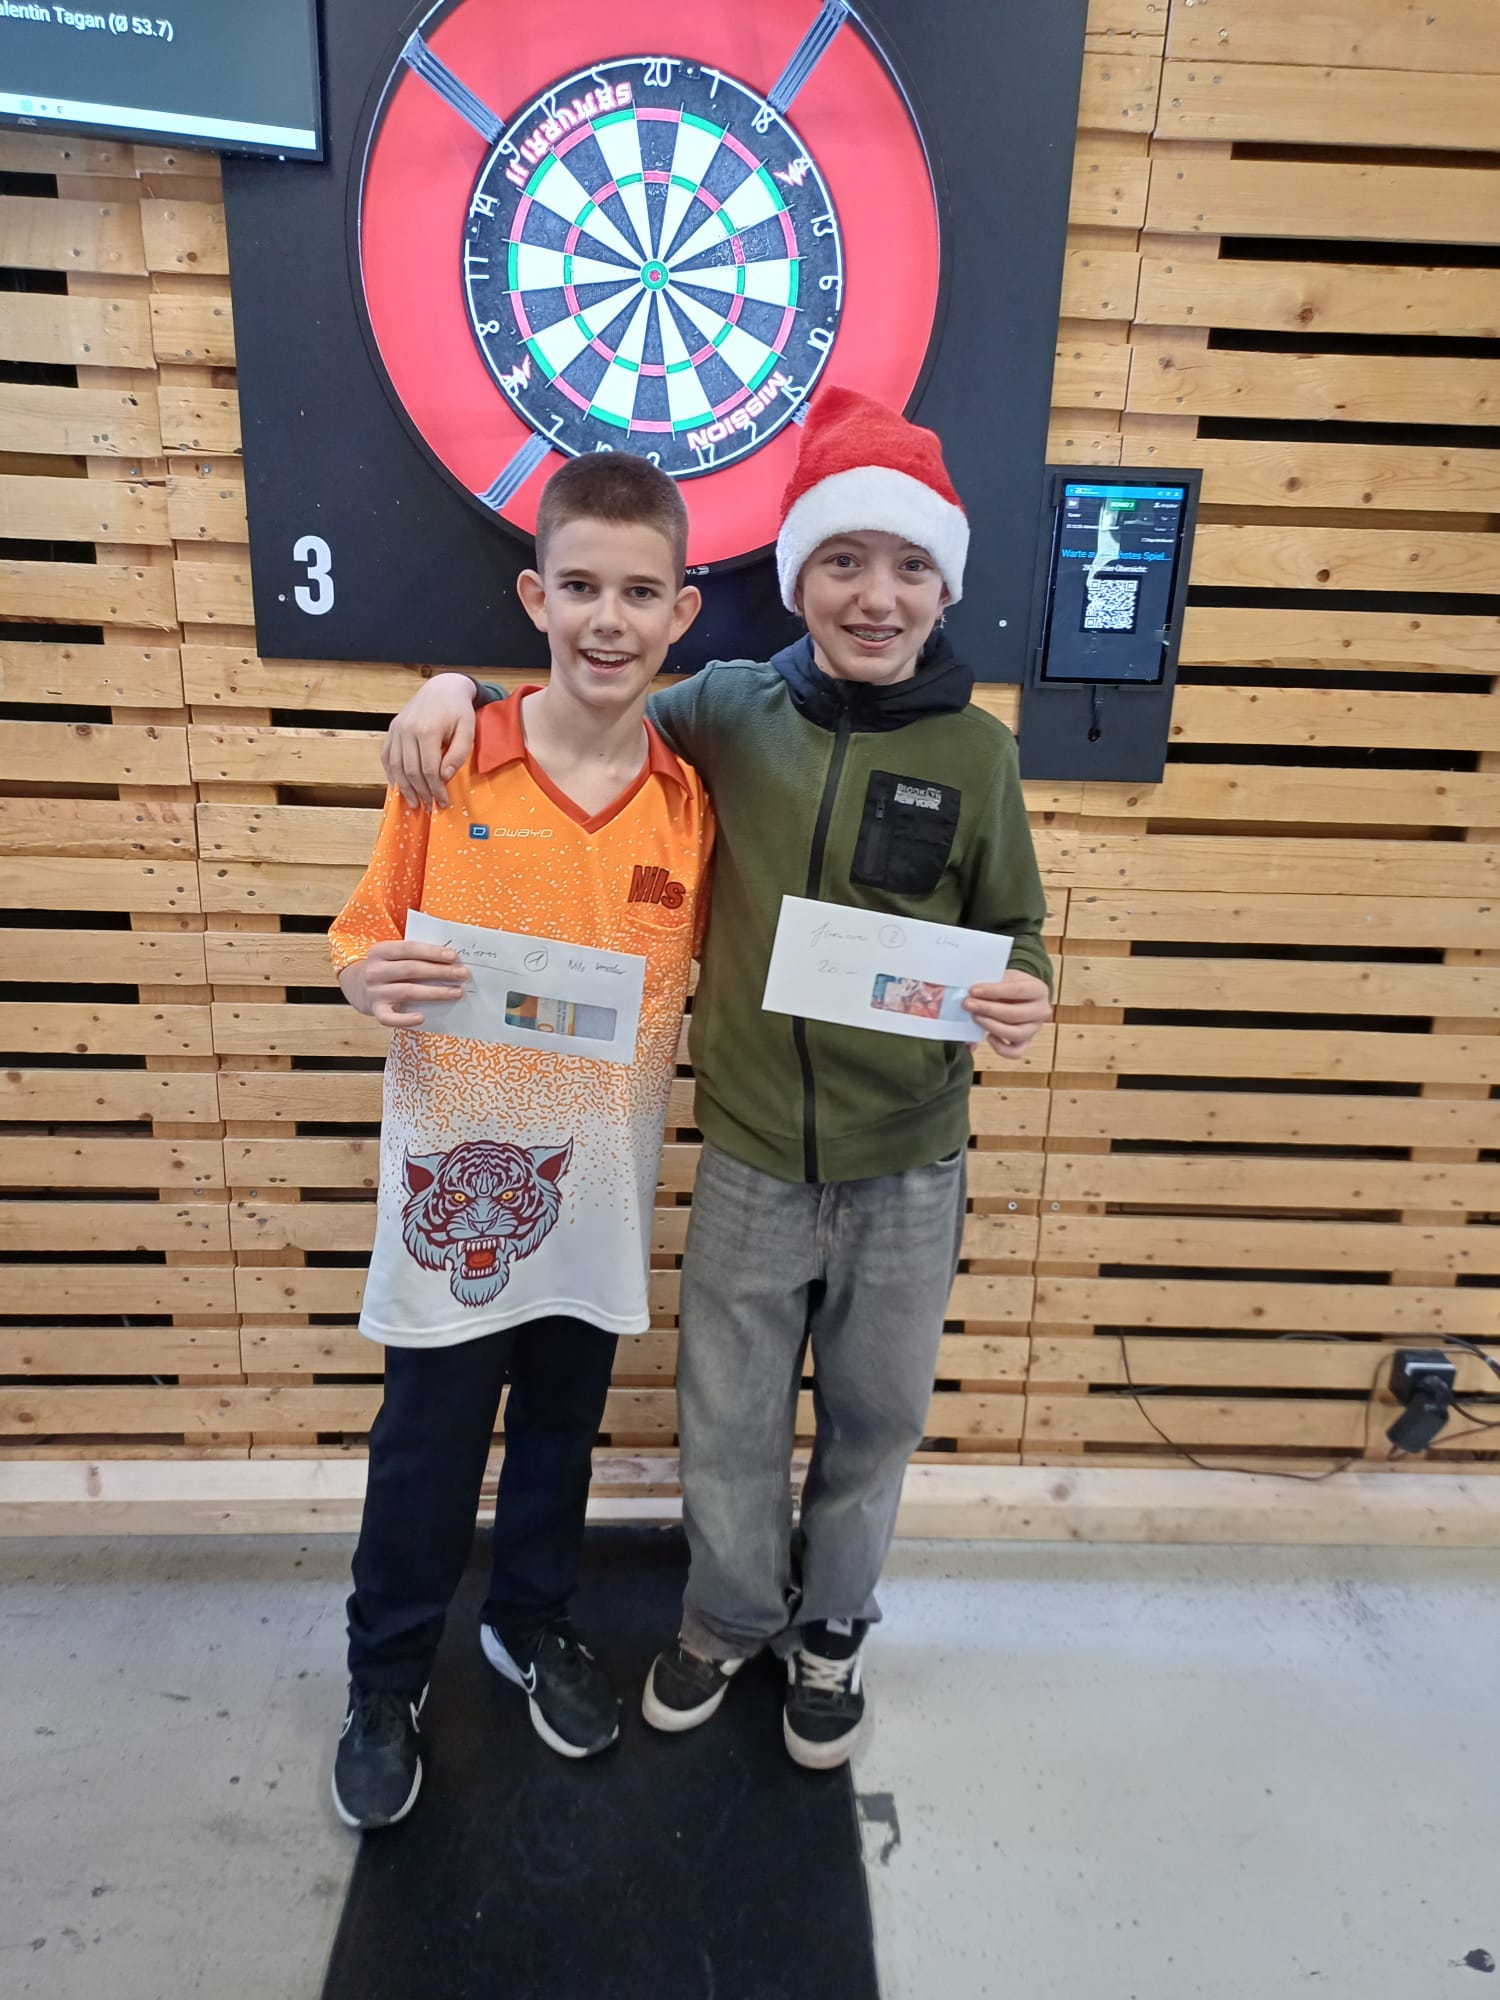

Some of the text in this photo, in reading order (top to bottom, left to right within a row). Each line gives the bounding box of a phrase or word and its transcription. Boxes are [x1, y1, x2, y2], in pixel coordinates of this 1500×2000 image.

[52, 6, 106, 31] Tagan
[132, 17, 173, 42] 53.7)
[643, 58, 671, 87] 20
[751, 102, 776, 133] 18
[470, 193, 499, 218] 14
[810, 213, 836, 237] 13
[465, 255, 490, 280] 11
[478, 319, 500, 337] 8
[807, 327, 835, 352] 10
[780, 375, 806, 404] 15
[686, 371, 786, 452] MISSION
[550, 414, 564, 436] 7
[743, 420, 757, 443] 2
[695, 443, 715, 469] 17
[1062, 548, 1087, 558] Warte
[293, 535, 335, 616] 3
[916, 797, 940, 811] YORK
[627, 864, 686, 909] Nils
